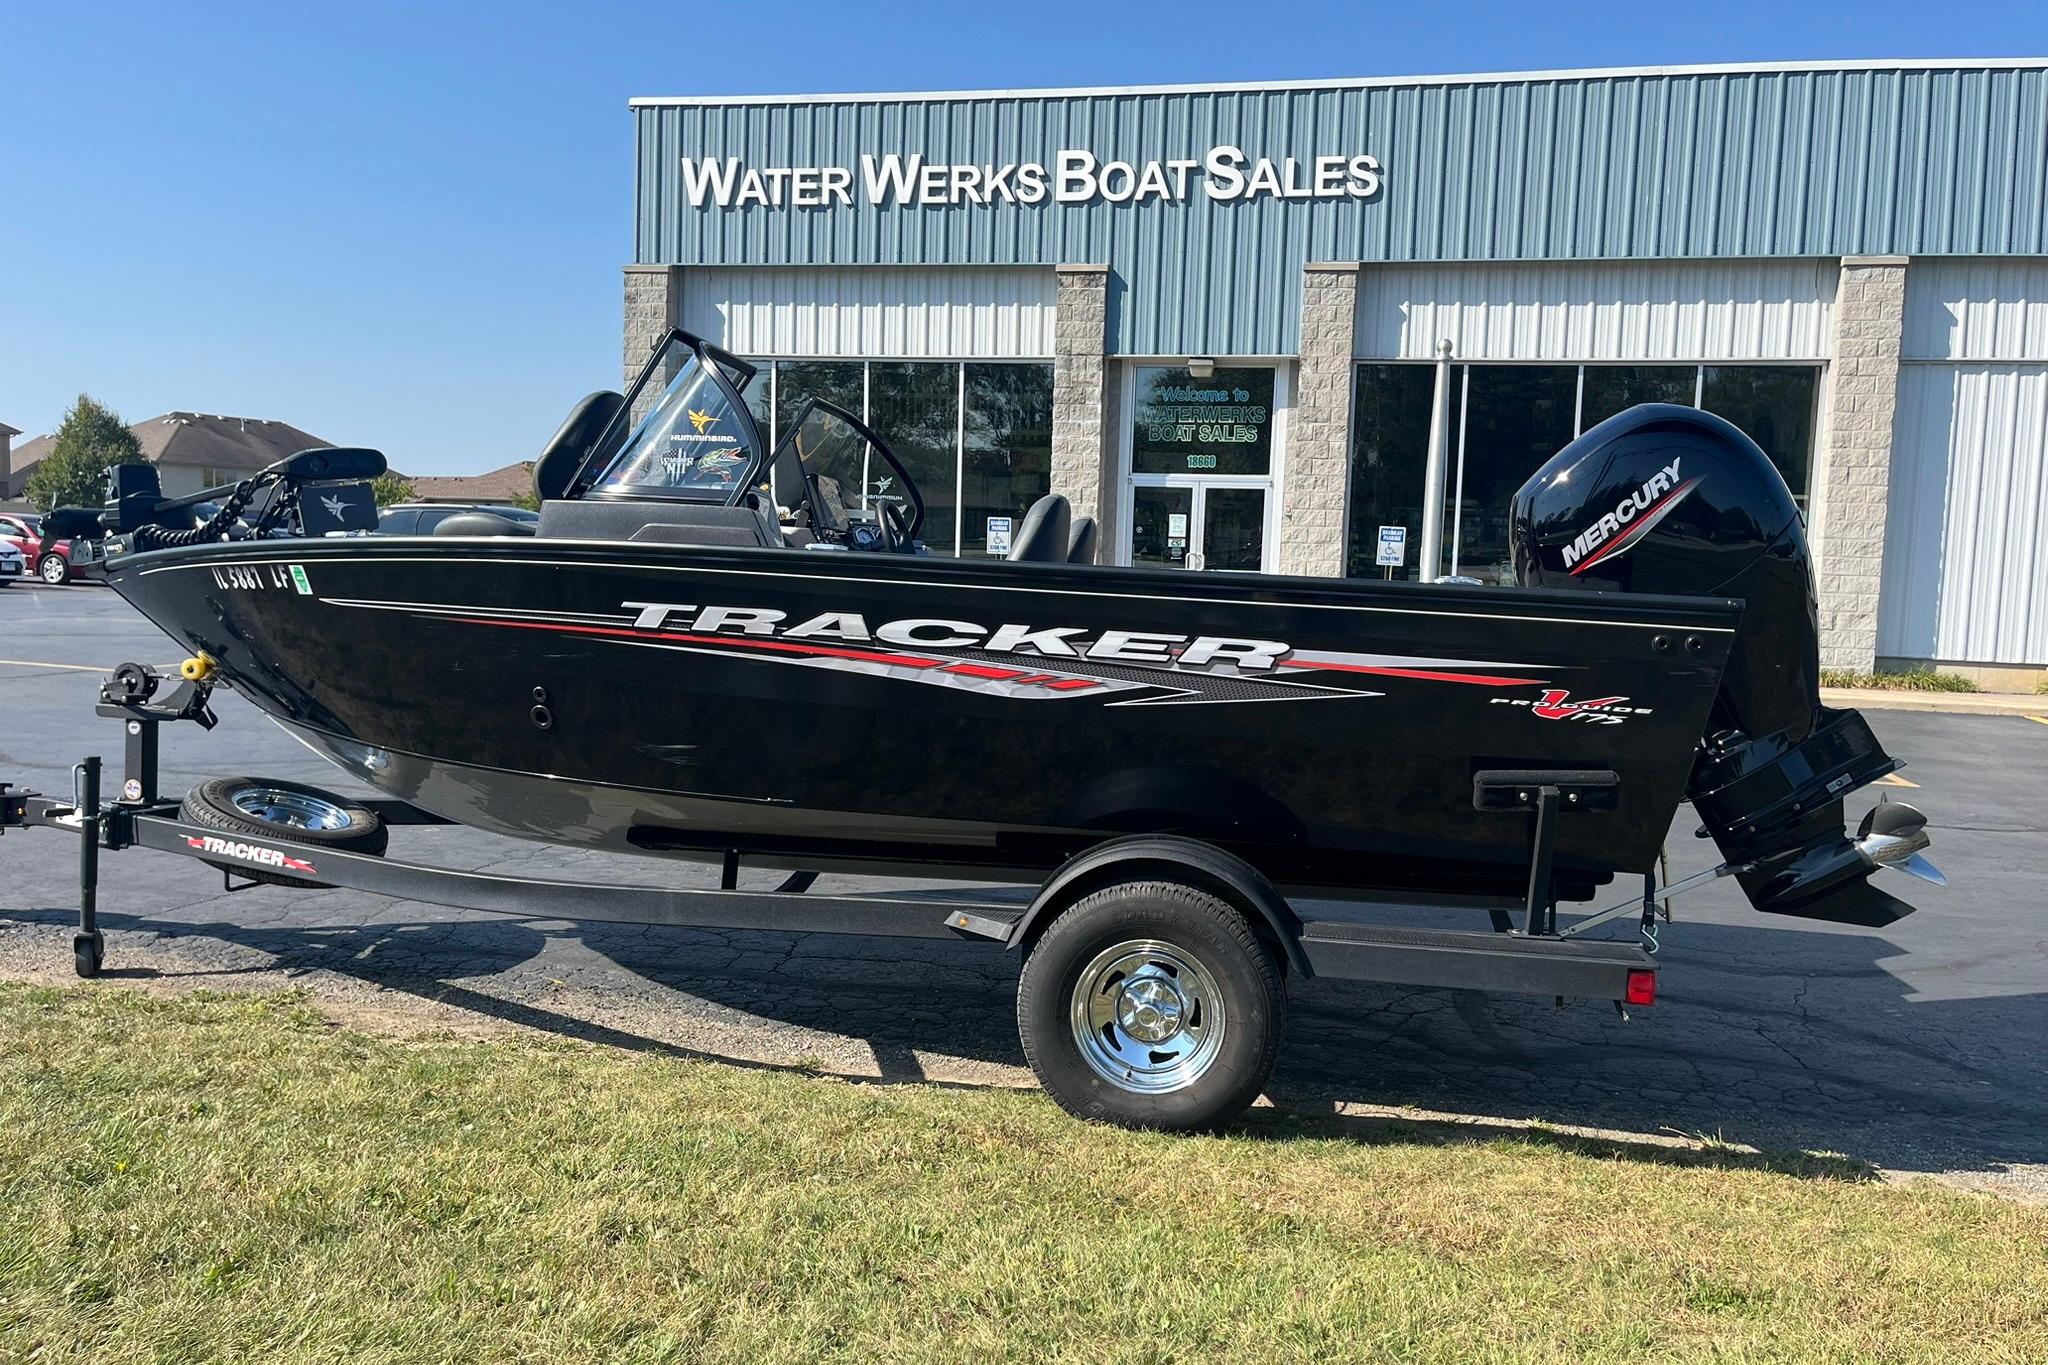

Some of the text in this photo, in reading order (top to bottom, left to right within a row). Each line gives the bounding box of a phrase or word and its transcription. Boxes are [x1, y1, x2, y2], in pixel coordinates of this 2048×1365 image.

[681, 145, 1380, 207] WATER WERKS BOAT SALES
[1160, 386, 1249, 402] Welcome to
[1143, 405, 1266, 423] WATERWERKS
[1148, 424, 1258, 442] BOAT SALES
[1187, 455, 1217, 468] 18660
[1561, 456, 1681, 568] MERCURY
[620, 601, 1291, 669] TRACKER
[1490, 698, 1653, 715] PRO GUIDE
[202, 836, 285, 867] TRACKER
